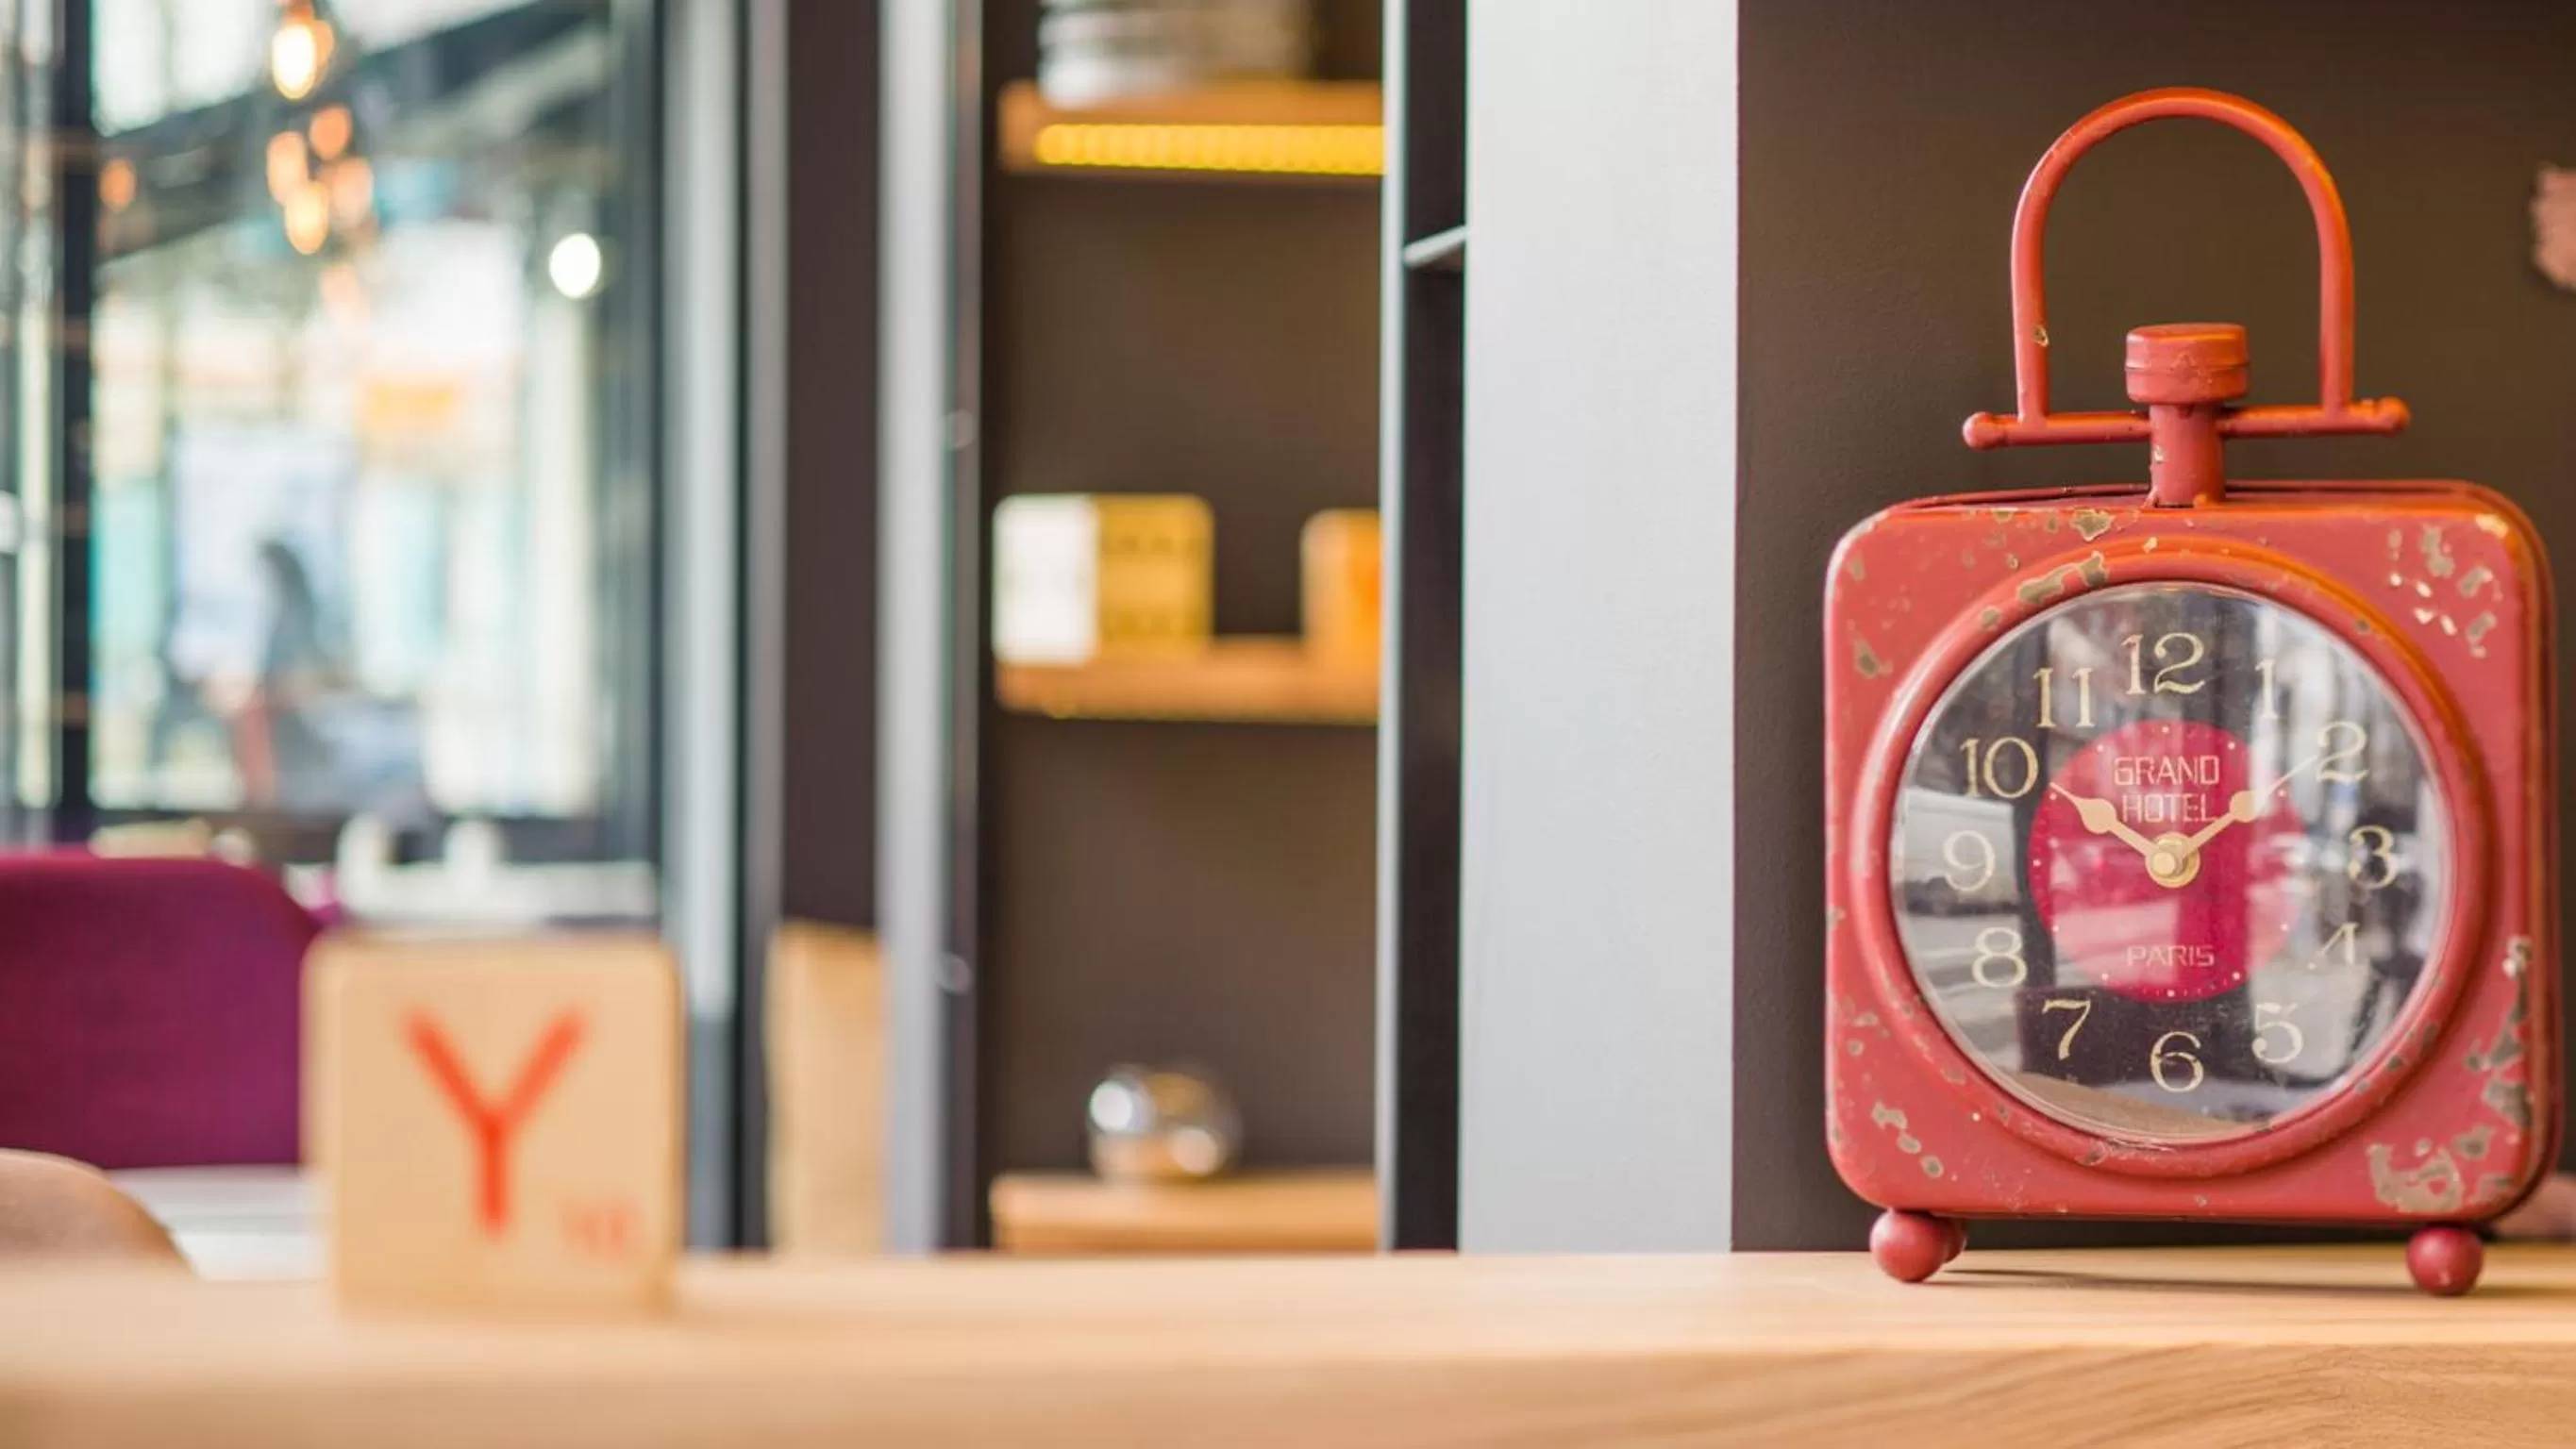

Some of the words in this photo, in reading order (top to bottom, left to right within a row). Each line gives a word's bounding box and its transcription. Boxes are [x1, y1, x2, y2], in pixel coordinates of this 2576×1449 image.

[2121, 632, 2206, 695] 12
[2254, 659, 2277, 720] 1
[2033, 667, 2096, 727] 11
[1960, 737, 2038, 799] 10
[2114, 756, 2219, 786] GRAND
[2316, 721, 2369, 783] 2
[2121, 792, 2218, 823] HOTEL
[1943, 830, 1996, 891] 9
[2349, 825, 2396, 890] 3
[1972, 926, 2026, 989] 8
[2127, 946, 2215, 968] PARIS
[2042, 998, 2091, 1060] 7
[2251, 1002, 2303, 1064] 5
[2149, 1031, 2205, 1092] 6
[404, 1008, 589, 1241] Y
